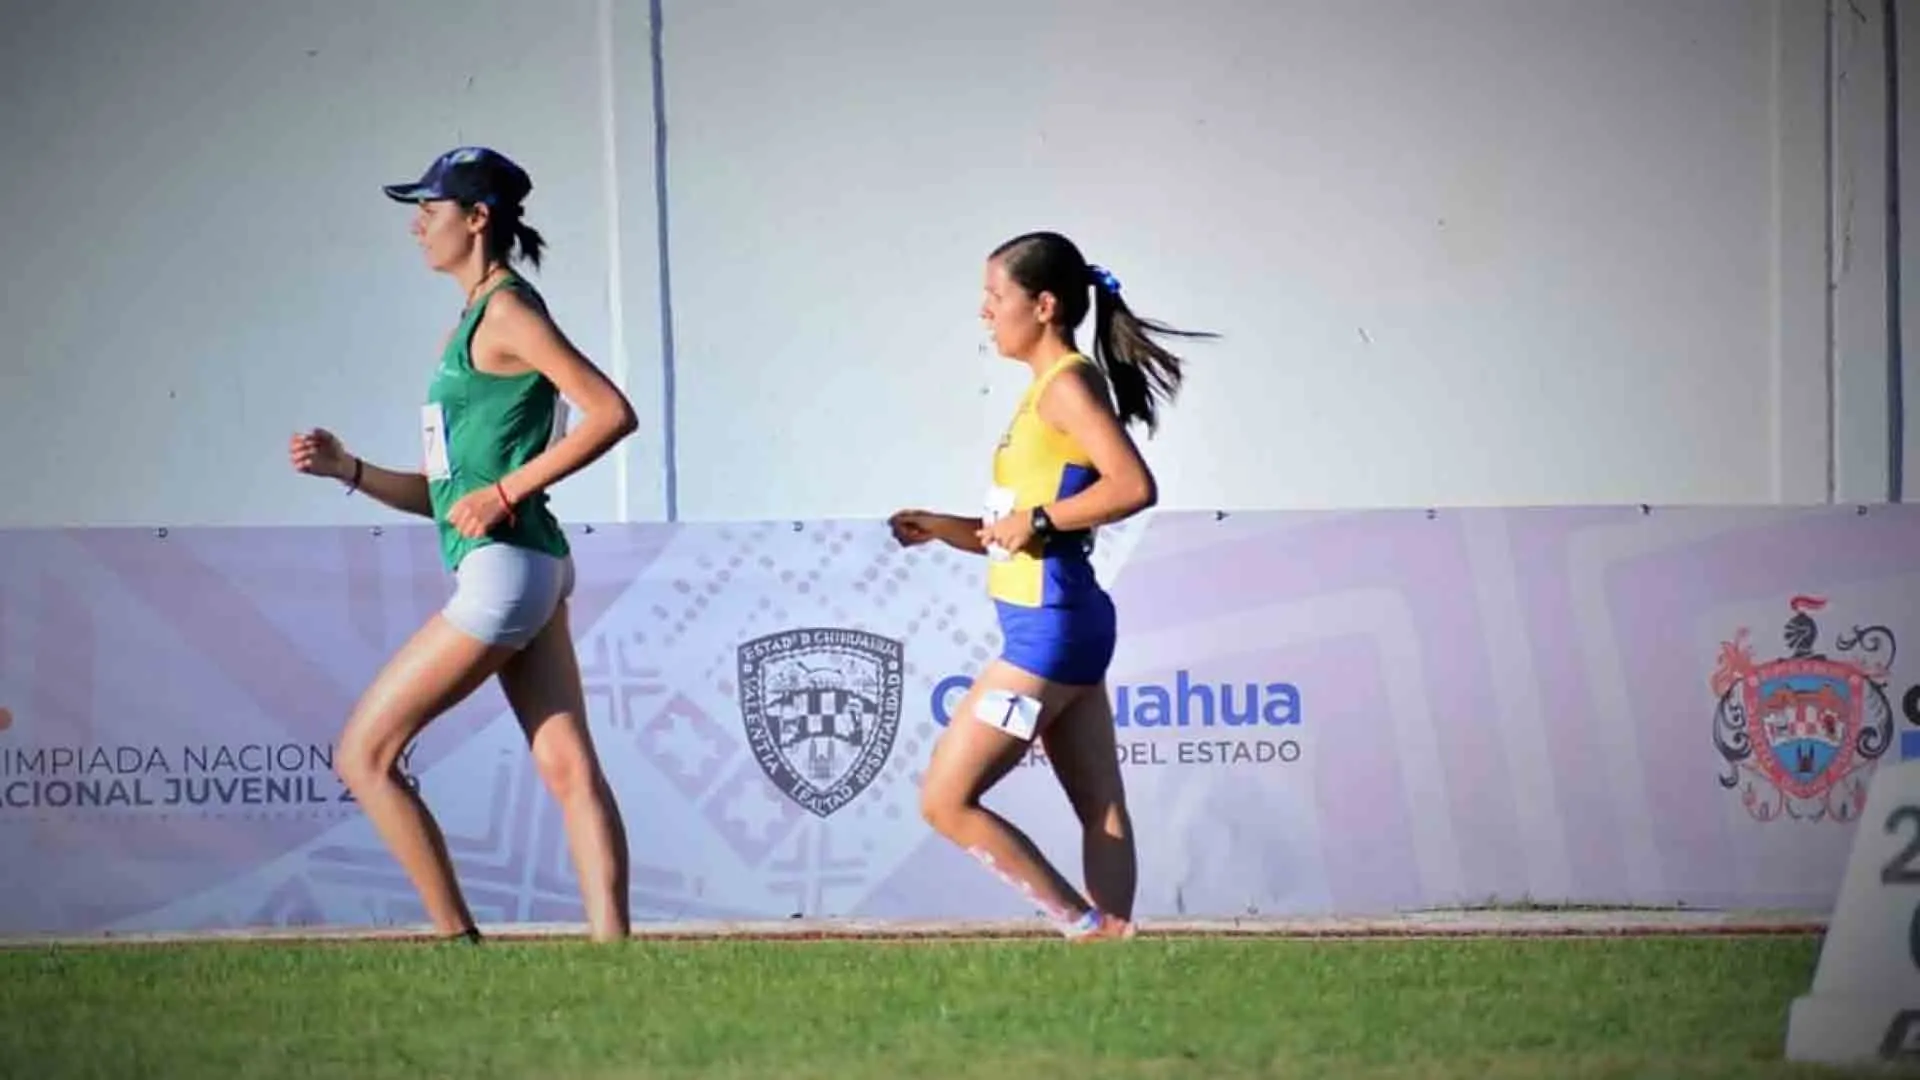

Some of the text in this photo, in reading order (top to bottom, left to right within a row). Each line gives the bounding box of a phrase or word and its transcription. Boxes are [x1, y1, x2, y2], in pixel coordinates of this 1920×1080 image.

[931, 670, 1301, 728] Cahua
[184, 743, 334, 774] NACION
[1178, 740, 1301, 764] ESTADO
[0, 779, 153, 808] CIONAL
[162, 777, 327, 806] JUVENIL
[790, 780, 854, 816] LEALTAD
